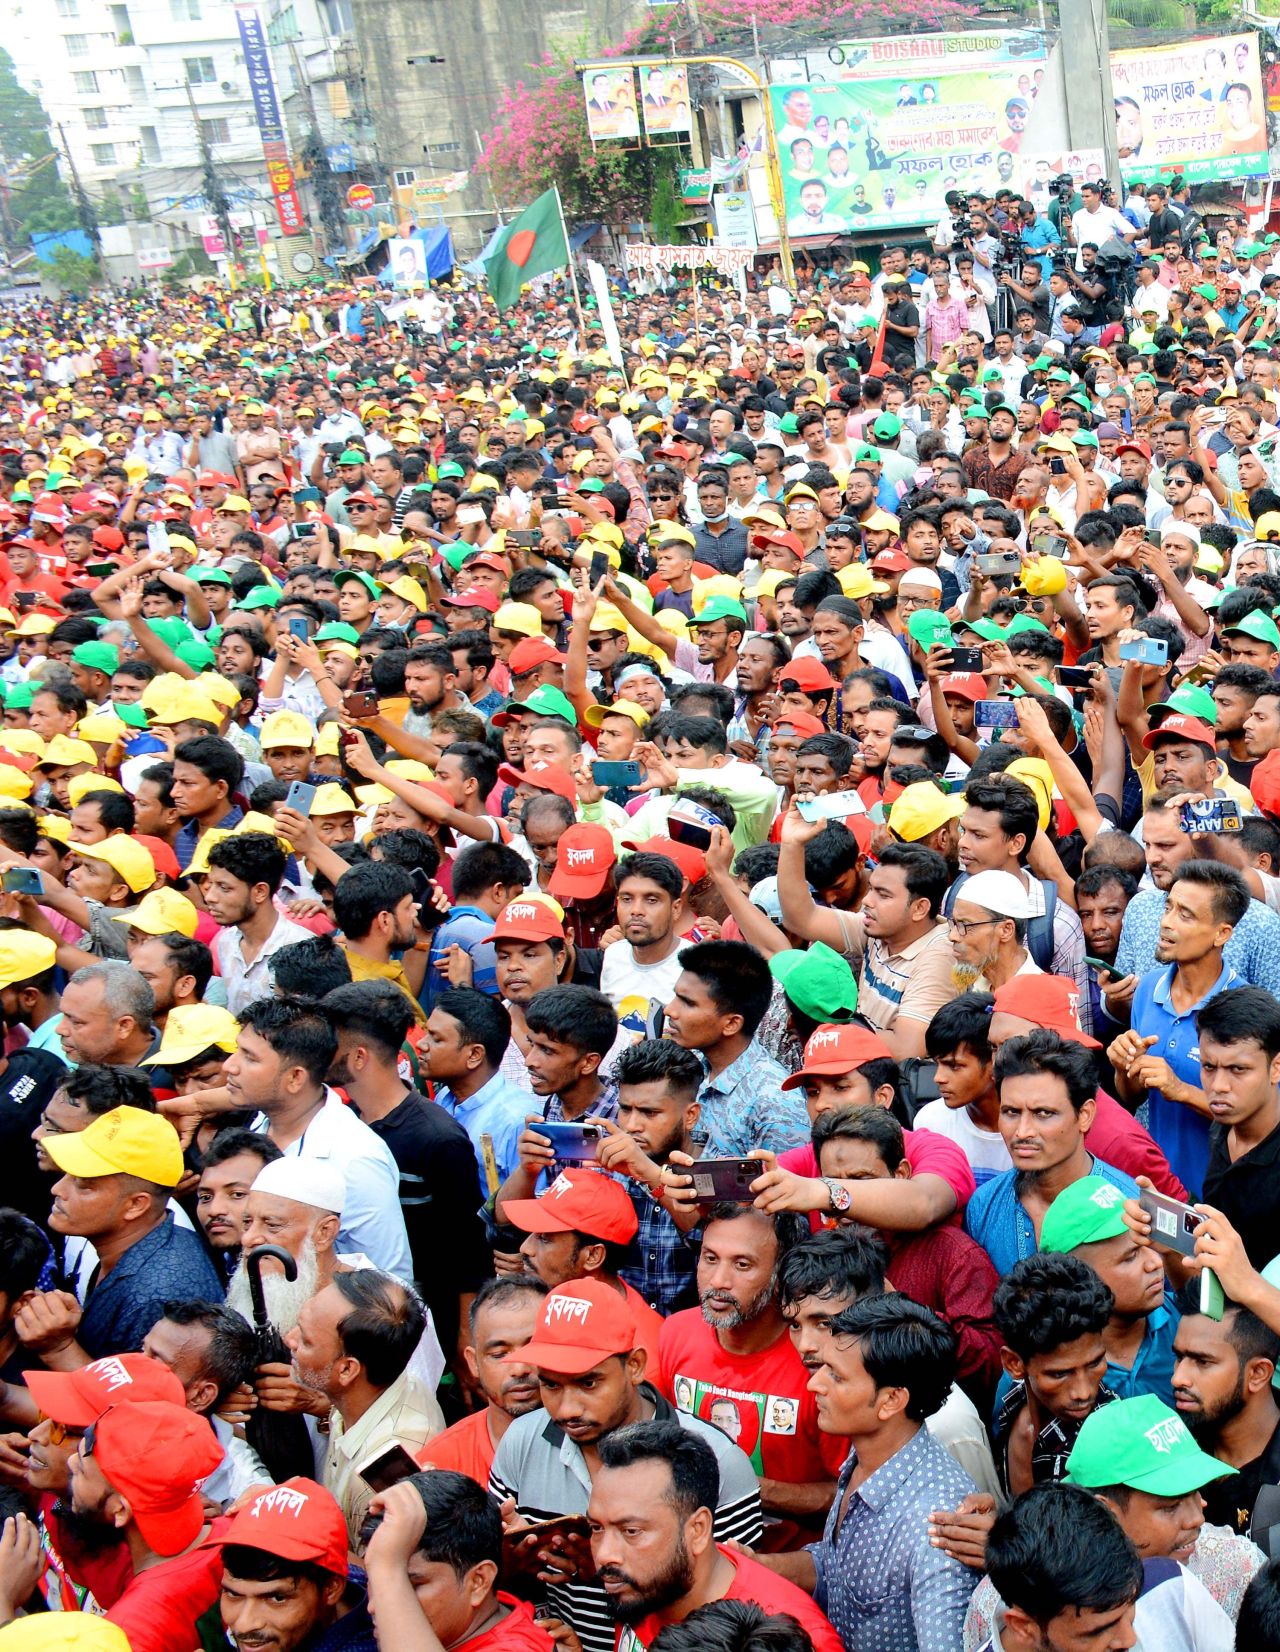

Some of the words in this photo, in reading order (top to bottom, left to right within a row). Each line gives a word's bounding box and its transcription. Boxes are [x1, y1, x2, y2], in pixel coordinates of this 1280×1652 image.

[872, 39, 944, 62] BOISHALI
[946, 36, 1001, 53] STUDIO
[250, 54, 268, 85] VIEW
[1142, 83, 1169, 103] সফল
[1171, 81, 1195, 103] হোক
[257, 89, 277, 126] HOTEL
[957, 126, 999, 145] সমাবেশ
[897, 157, 943, 174] সফল
[949, 152, 993, 172] হোক
[626, 245, 654, 270] আবু
[659, 246, 705, 268] হাসনাত
[711, 248, 755, 275] জুয়েল
[1188, 818, 1222, 832] AAPE
[567, 848, 595, 867] যুবদল
[505, 903, 537, 922] যুবদল
[808, 1031, 841, 1057] যুবদল
[545, 1294, 592, 1326] যুবদল
[727, 1388, 764, 1404] Bangladesh
[251, 1487, 309, 1518] যুবদল
